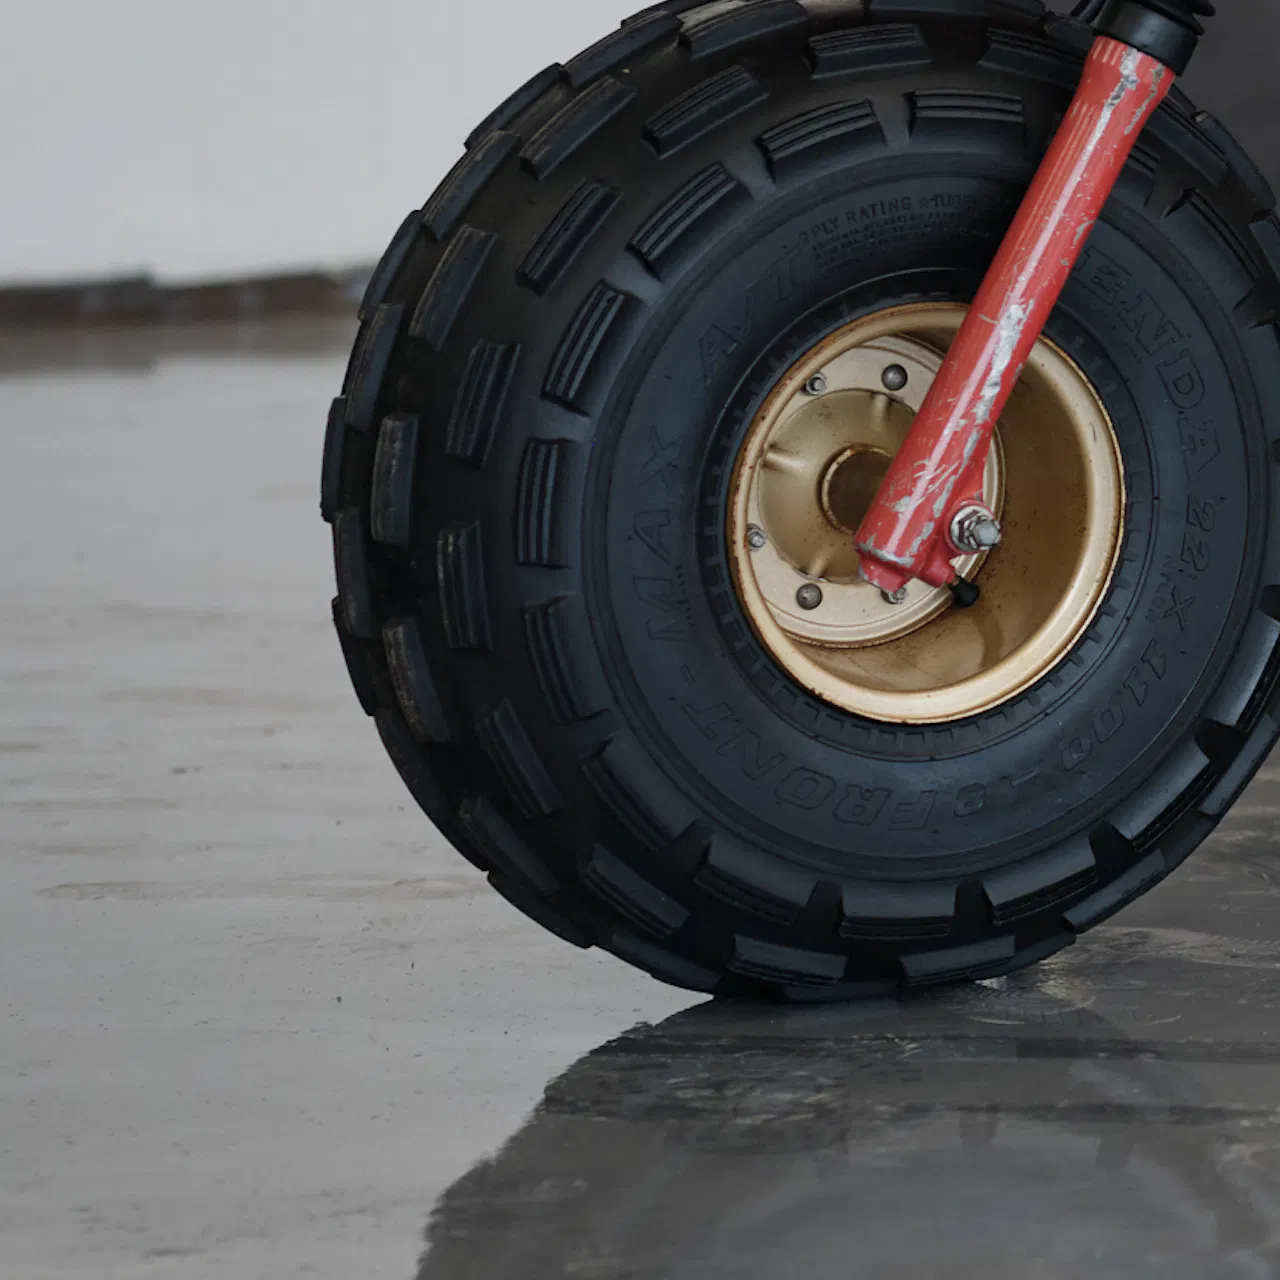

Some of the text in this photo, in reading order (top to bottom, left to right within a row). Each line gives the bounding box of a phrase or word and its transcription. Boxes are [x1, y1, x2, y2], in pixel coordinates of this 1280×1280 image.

[845, 196, 913, 225] RATING
[1071, 247, 1223, 485] ENDA
[632, 424, 682, 644] MAX
[1180, 495, 1217, 573] 22
[681, 701, 937, 831] FRONT
